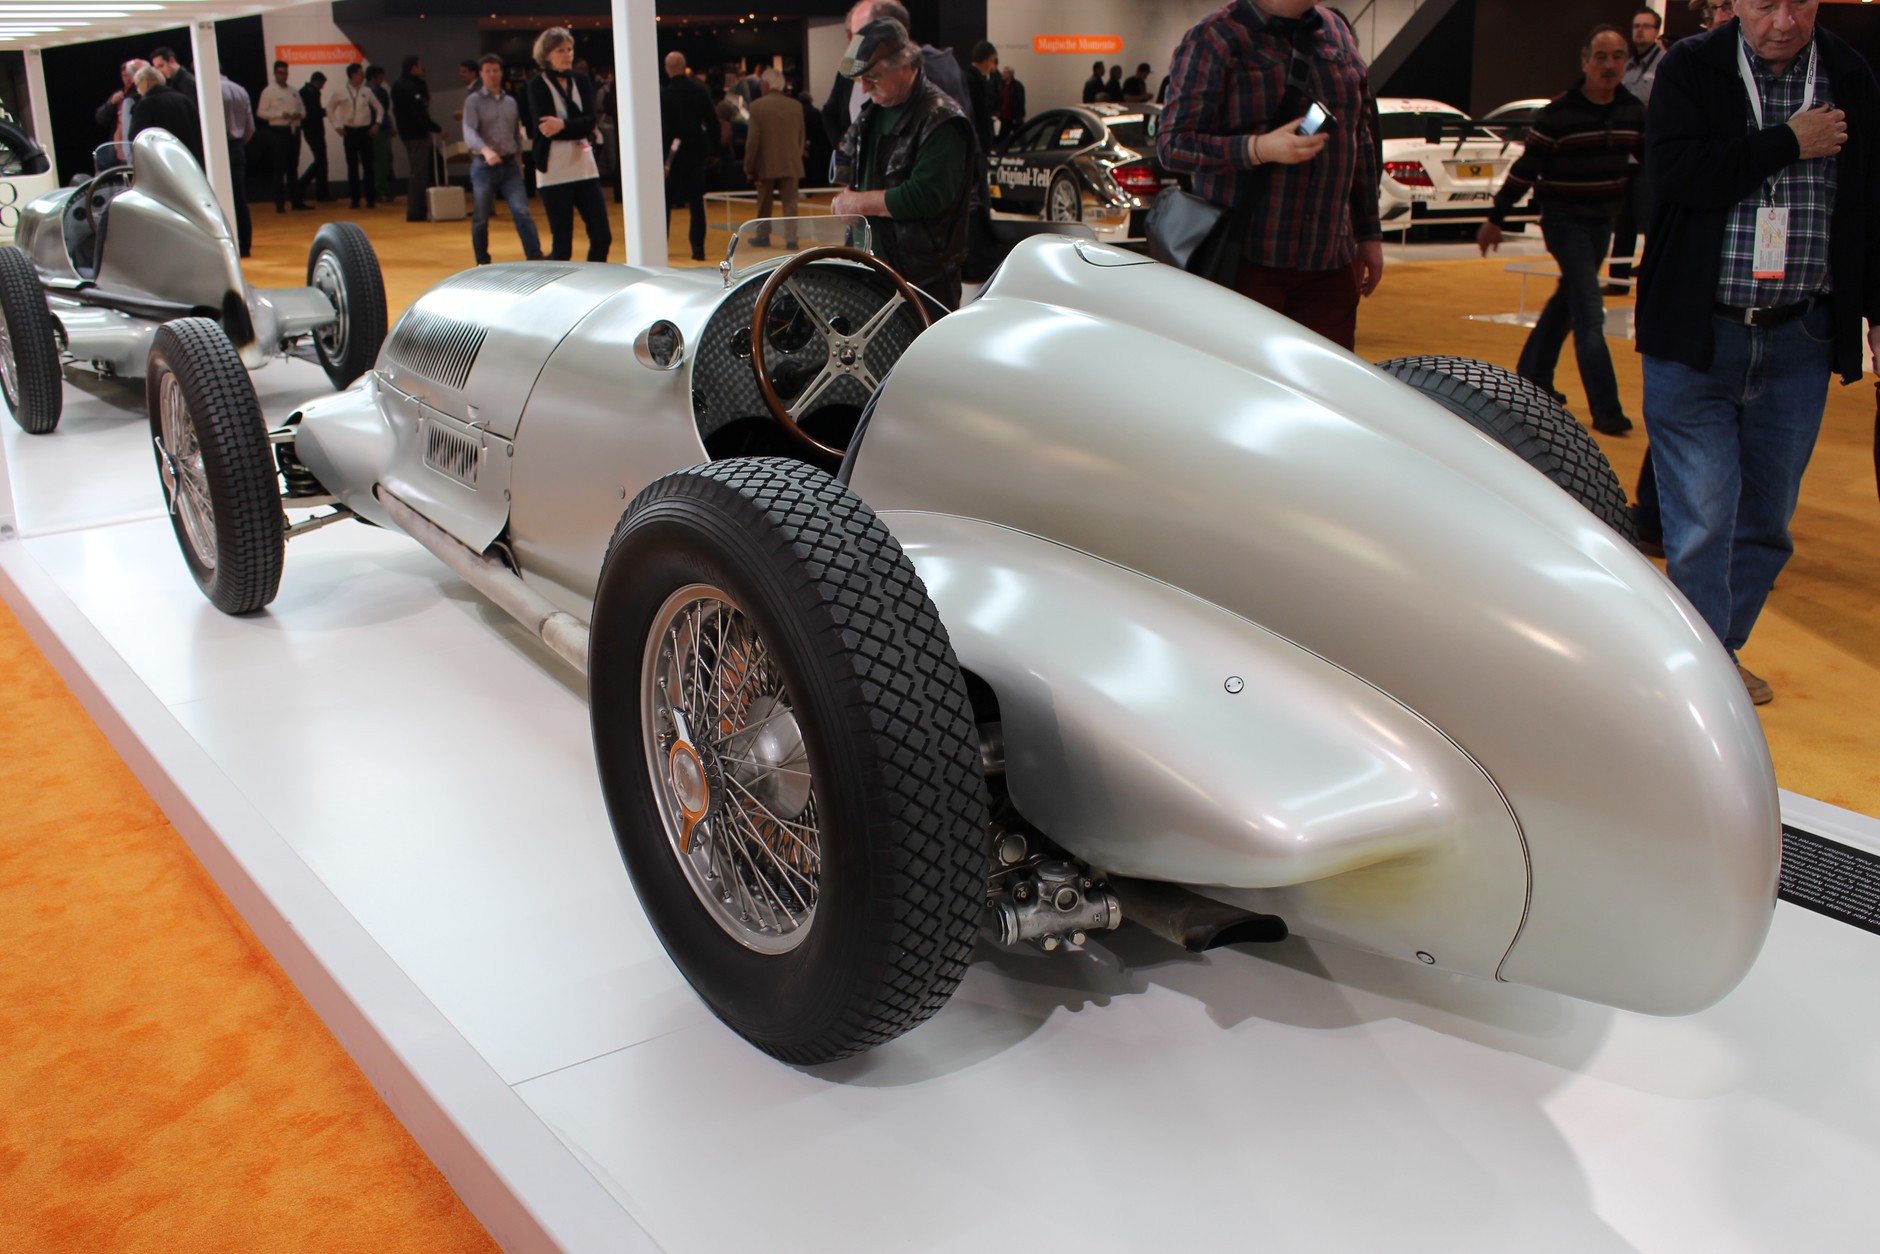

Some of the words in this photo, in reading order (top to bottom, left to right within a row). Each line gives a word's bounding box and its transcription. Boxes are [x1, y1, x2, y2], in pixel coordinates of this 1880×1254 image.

[1038, 38, 1077, 52] Magische
[1079, 39, 1116, 50] Momente
[281, 47, 357, 62] Museumsshop
